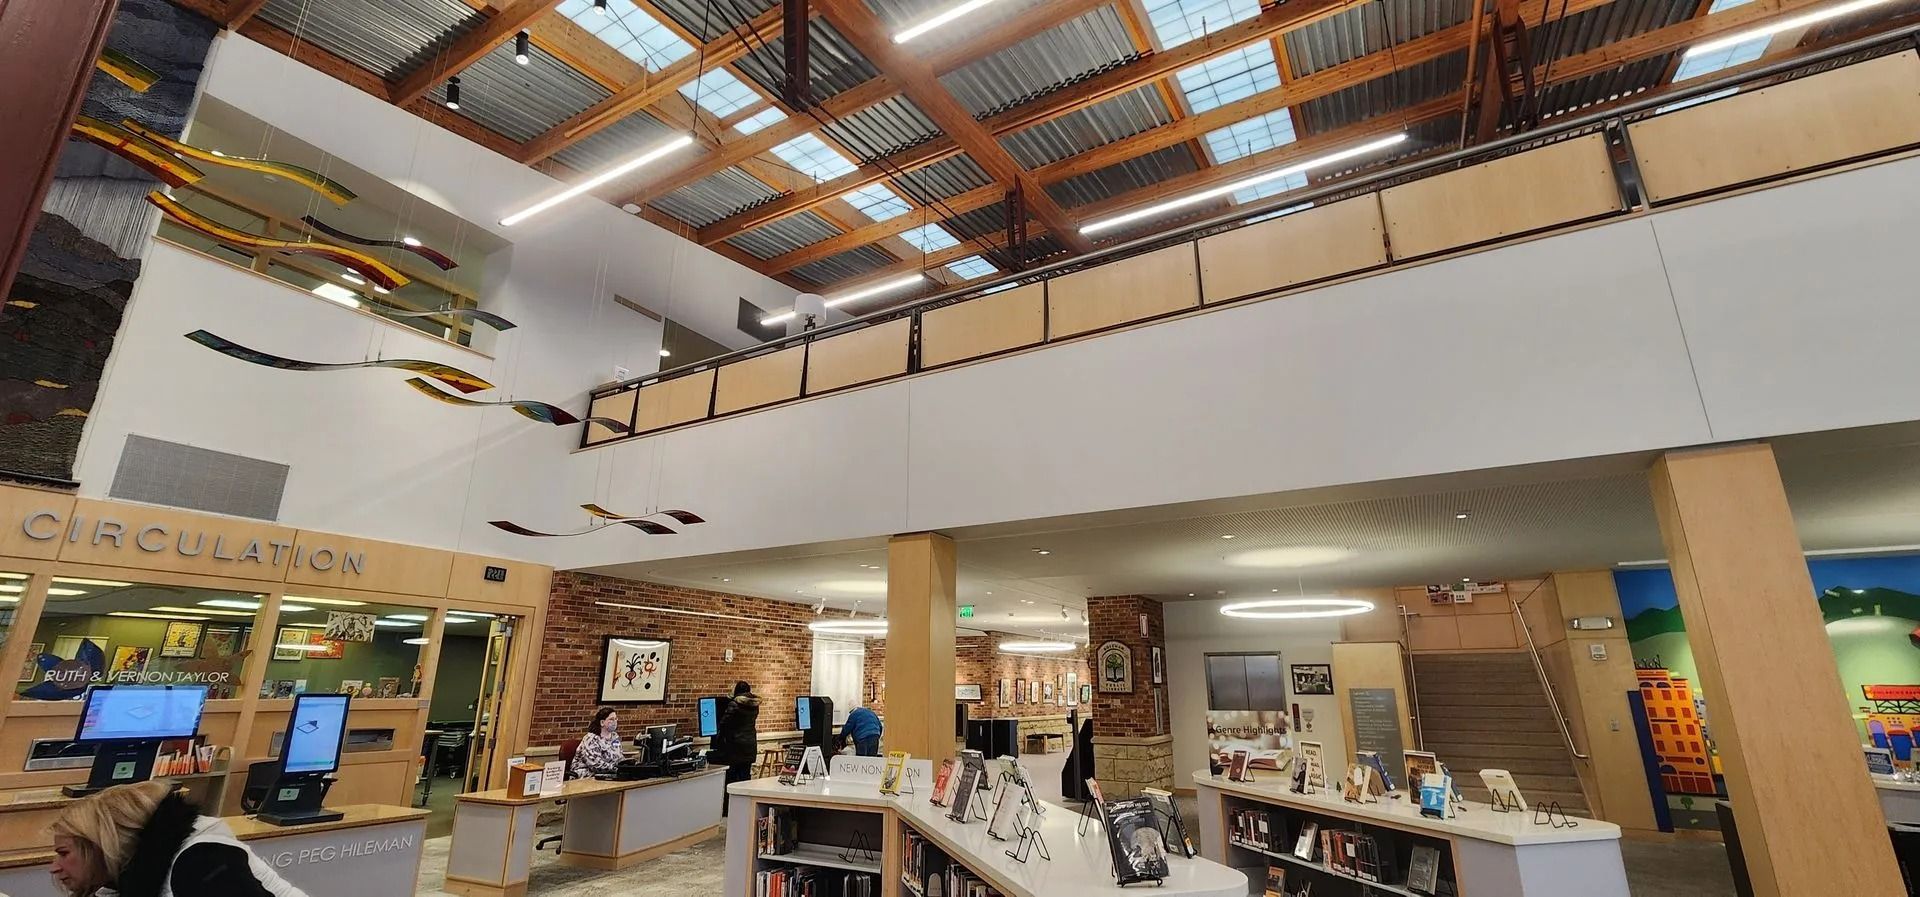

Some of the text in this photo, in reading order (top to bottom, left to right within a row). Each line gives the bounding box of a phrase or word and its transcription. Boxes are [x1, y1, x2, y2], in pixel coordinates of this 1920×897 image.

[22, 511, 366, 575] CIRCULATION
[44, 669, 230, 683] RUTH & VERNON TAYLOR
[1215, 725, 1288, 736] Genre Highlights
[840, 763, 859, 773] NEW
[298, 846, 336, 865] PEG
[340, 834, 414, 858] HILEMAN
